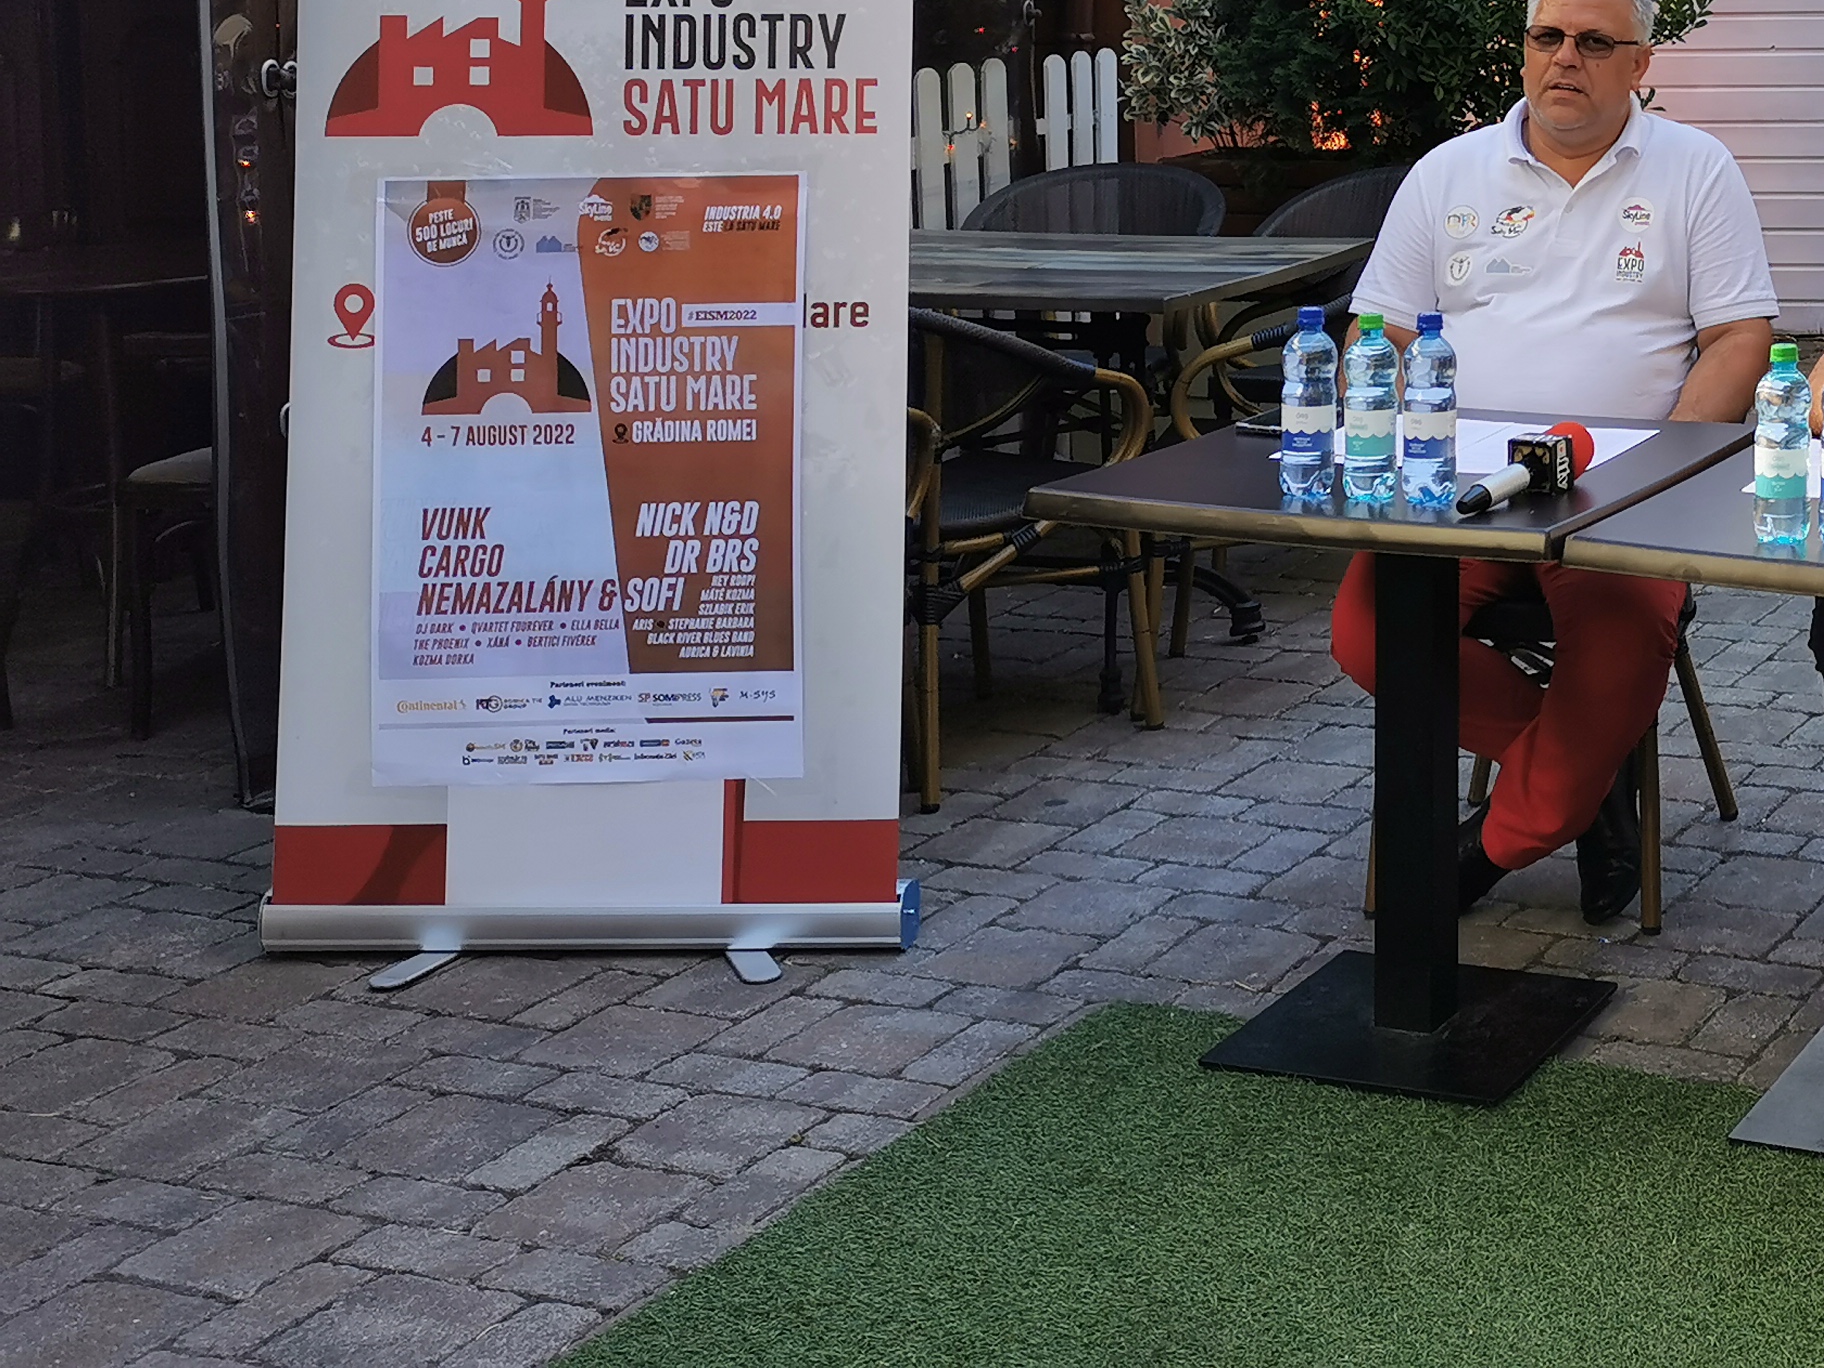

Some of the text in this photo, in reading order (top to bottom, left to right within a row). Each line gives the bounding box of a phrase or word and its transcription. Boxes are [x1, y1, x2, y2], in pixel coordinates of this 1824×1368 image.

[624, 13, 846, 70] INDUSTRY
[622, 77, 878, 136] SATU MARE
[428, 208, 454, 225] PESTE
[704, 205, 783, 221] INDUSTRIA 4.0
[415, 217, 474, 242] 500 LOCURI
[702, 219, 781, 233] ESTE SATU MARE
[426, 239, 438, 254] DE
[1617, 257, 1645, 272] EXPO
[611, 297, 677, 334] EXPO
[687, 310, 758, 321] #EISM2022
[611, 335, 739, 373] INDUSTRY
[610, 374, 758, 413] SATU MARE
[421, 424, 576, 447] 4 7 AUGUST 2022
[631, 417, 757, 443] GRĂDINA ROMEI
[421, 506, 491, 541] VUNK
[634, 501, 760, 538] NICK N&D
[417, 543, 505, 579] CARGO
[663, 538, 760, 575] DR BRS
[416, 575, 685, 617] NEMAZALÁNY & SOFI
[700, 586, 756, 602] MÁTÉ KOZMA
[734, 602, 756, 615] ERIK
[415, 624, 428, 634] DJ
[429, 622, 454, 634] DARK
[471, 620, 509, 634] QVARTET
[570, 619, 592, 631] ELLA
[593, 618, 620, 631] BELLA
[667, 617, 714, 631] STEPHANIE
[413, 638, 429, 650] THE
[430, 637, 470, 650] PHOENIX
[561, 633, 597, 647] FIVÉREK
[647, 632, 676, 645] BLACK
[676, 632, 701, 644] RIVER
[412, 653, 475, 666] KOZMA DORKA
[564, 694, 633, 703] ALU MENZIKEN
[637, 692, 651, 703] SP
[397, 699, 458, 714] Continental
